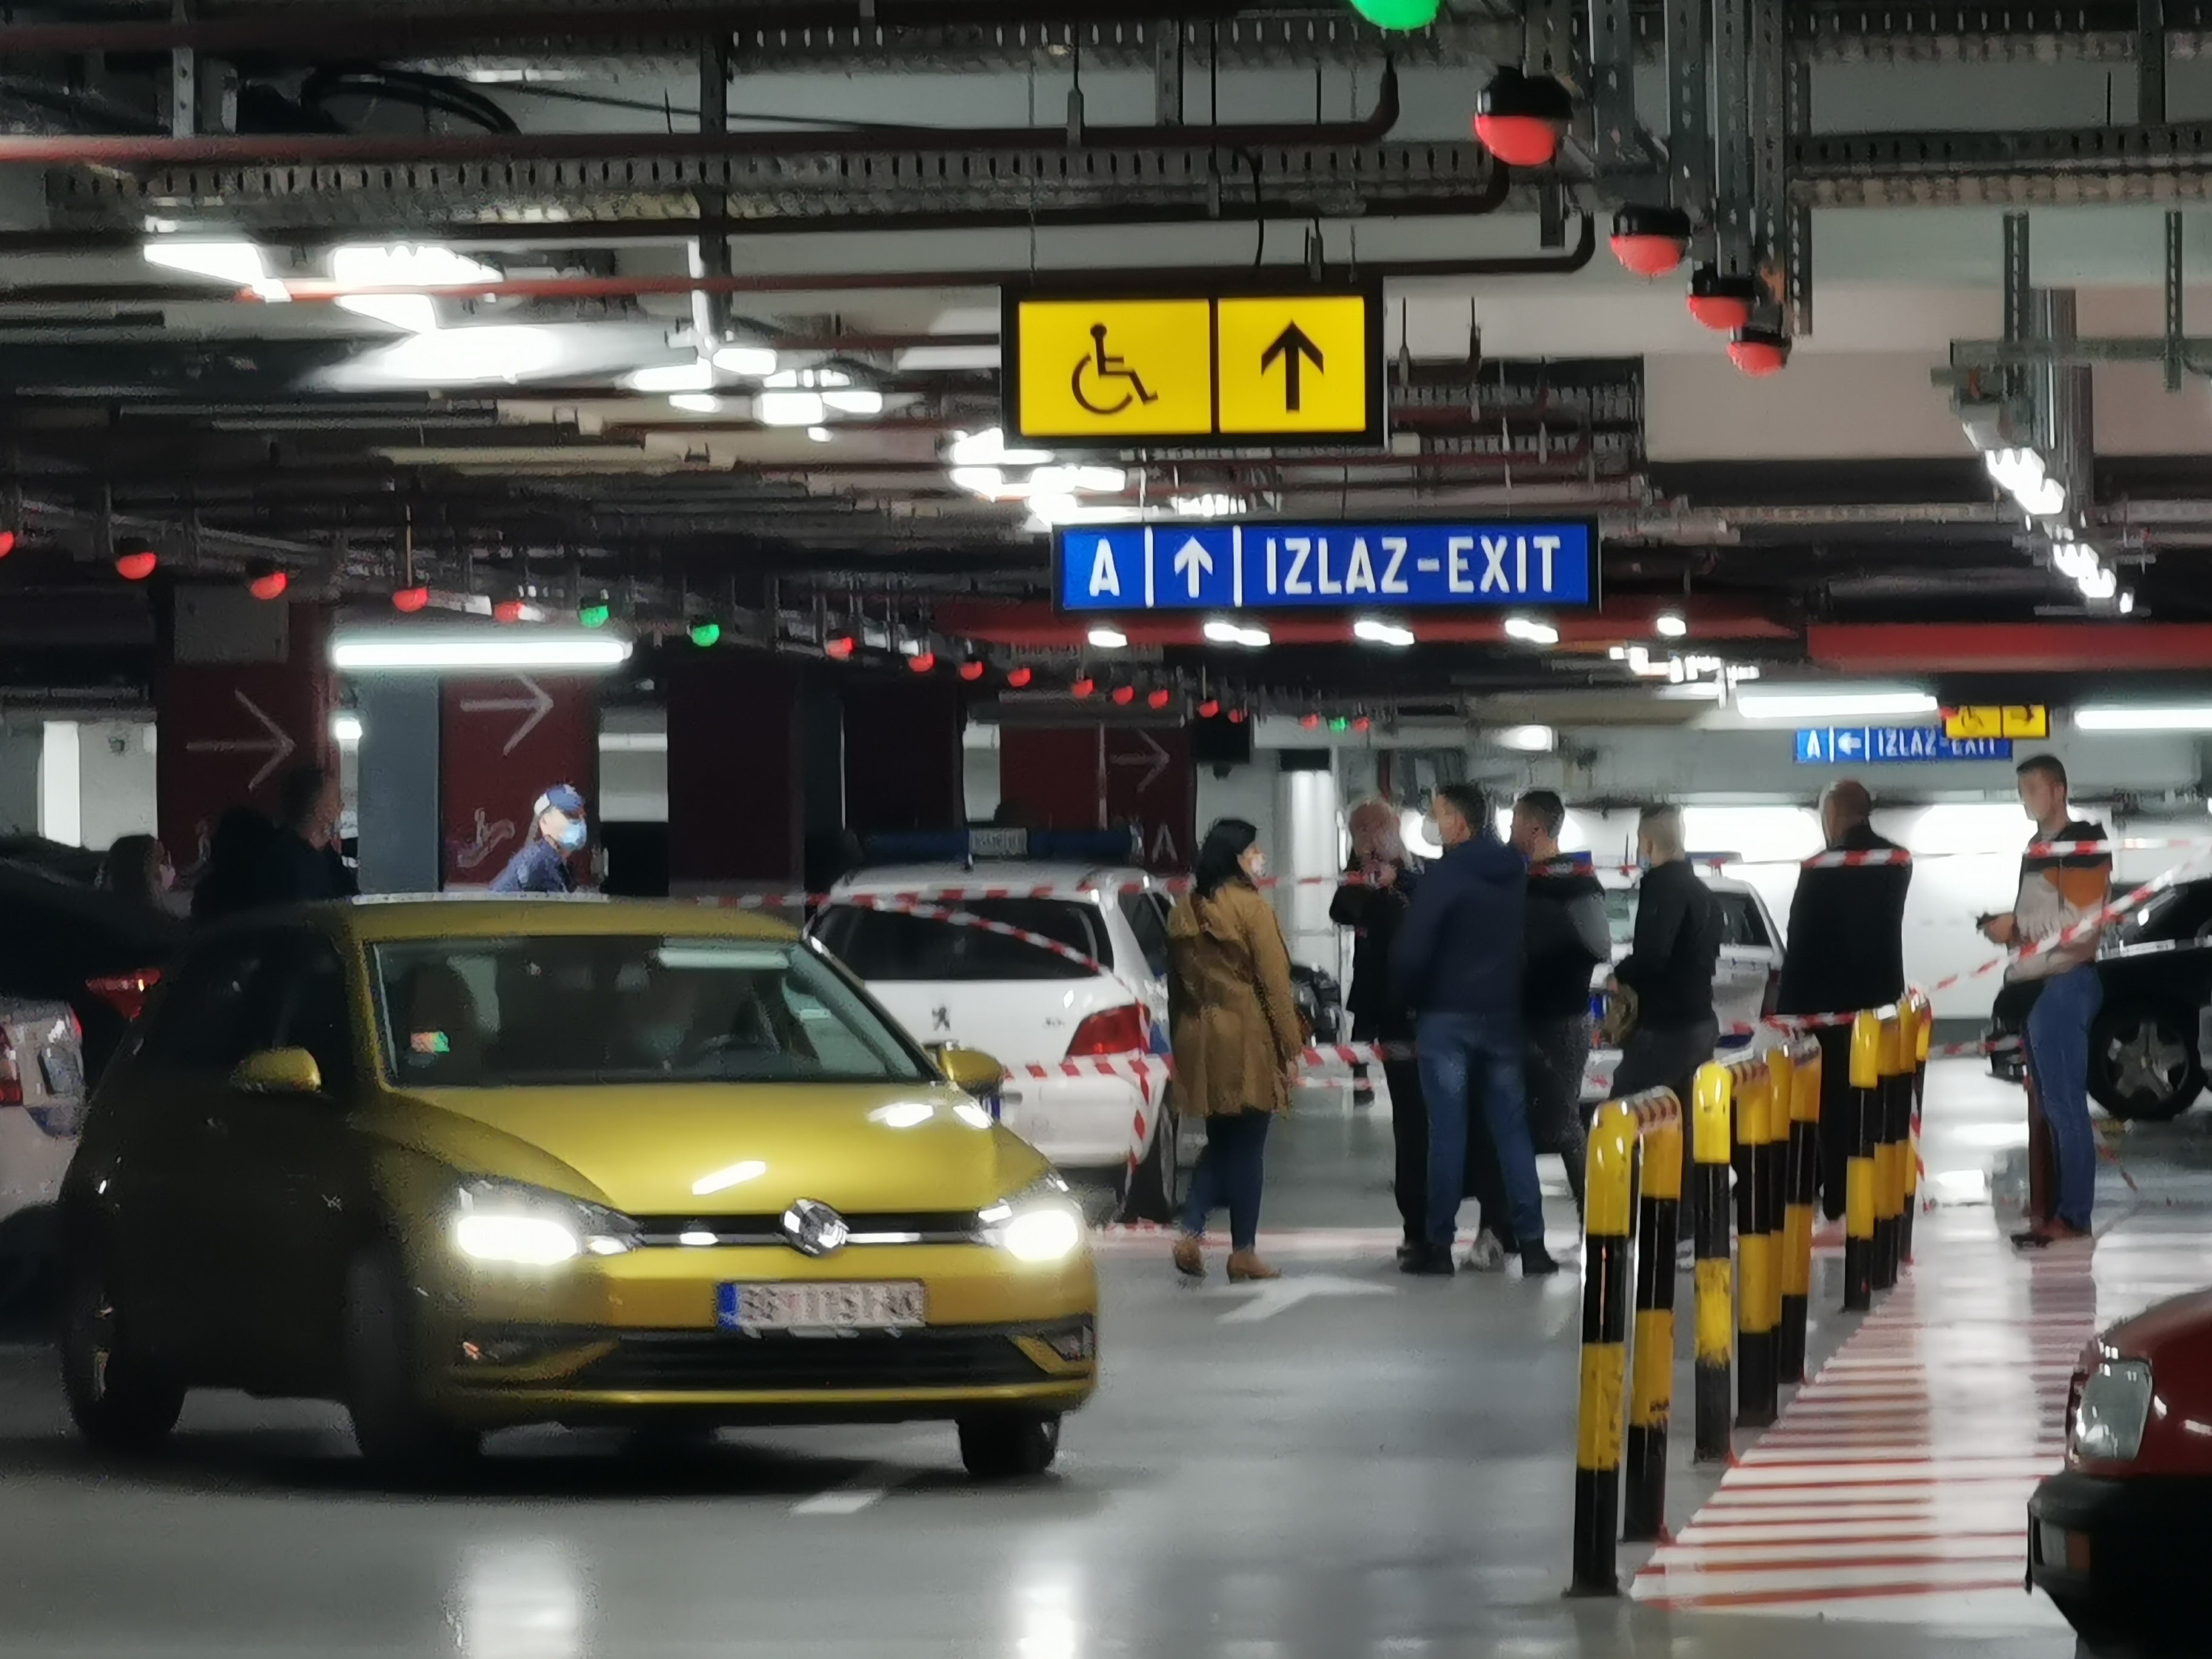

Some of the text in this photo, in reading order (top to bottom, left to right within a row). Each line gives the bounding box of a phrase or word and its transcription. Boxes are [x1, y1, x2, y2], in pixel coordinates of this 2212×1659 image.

[1089, 536, 1561, 597] A IZLAZ-EXIT
[1807, 729, 1821, 759] A
